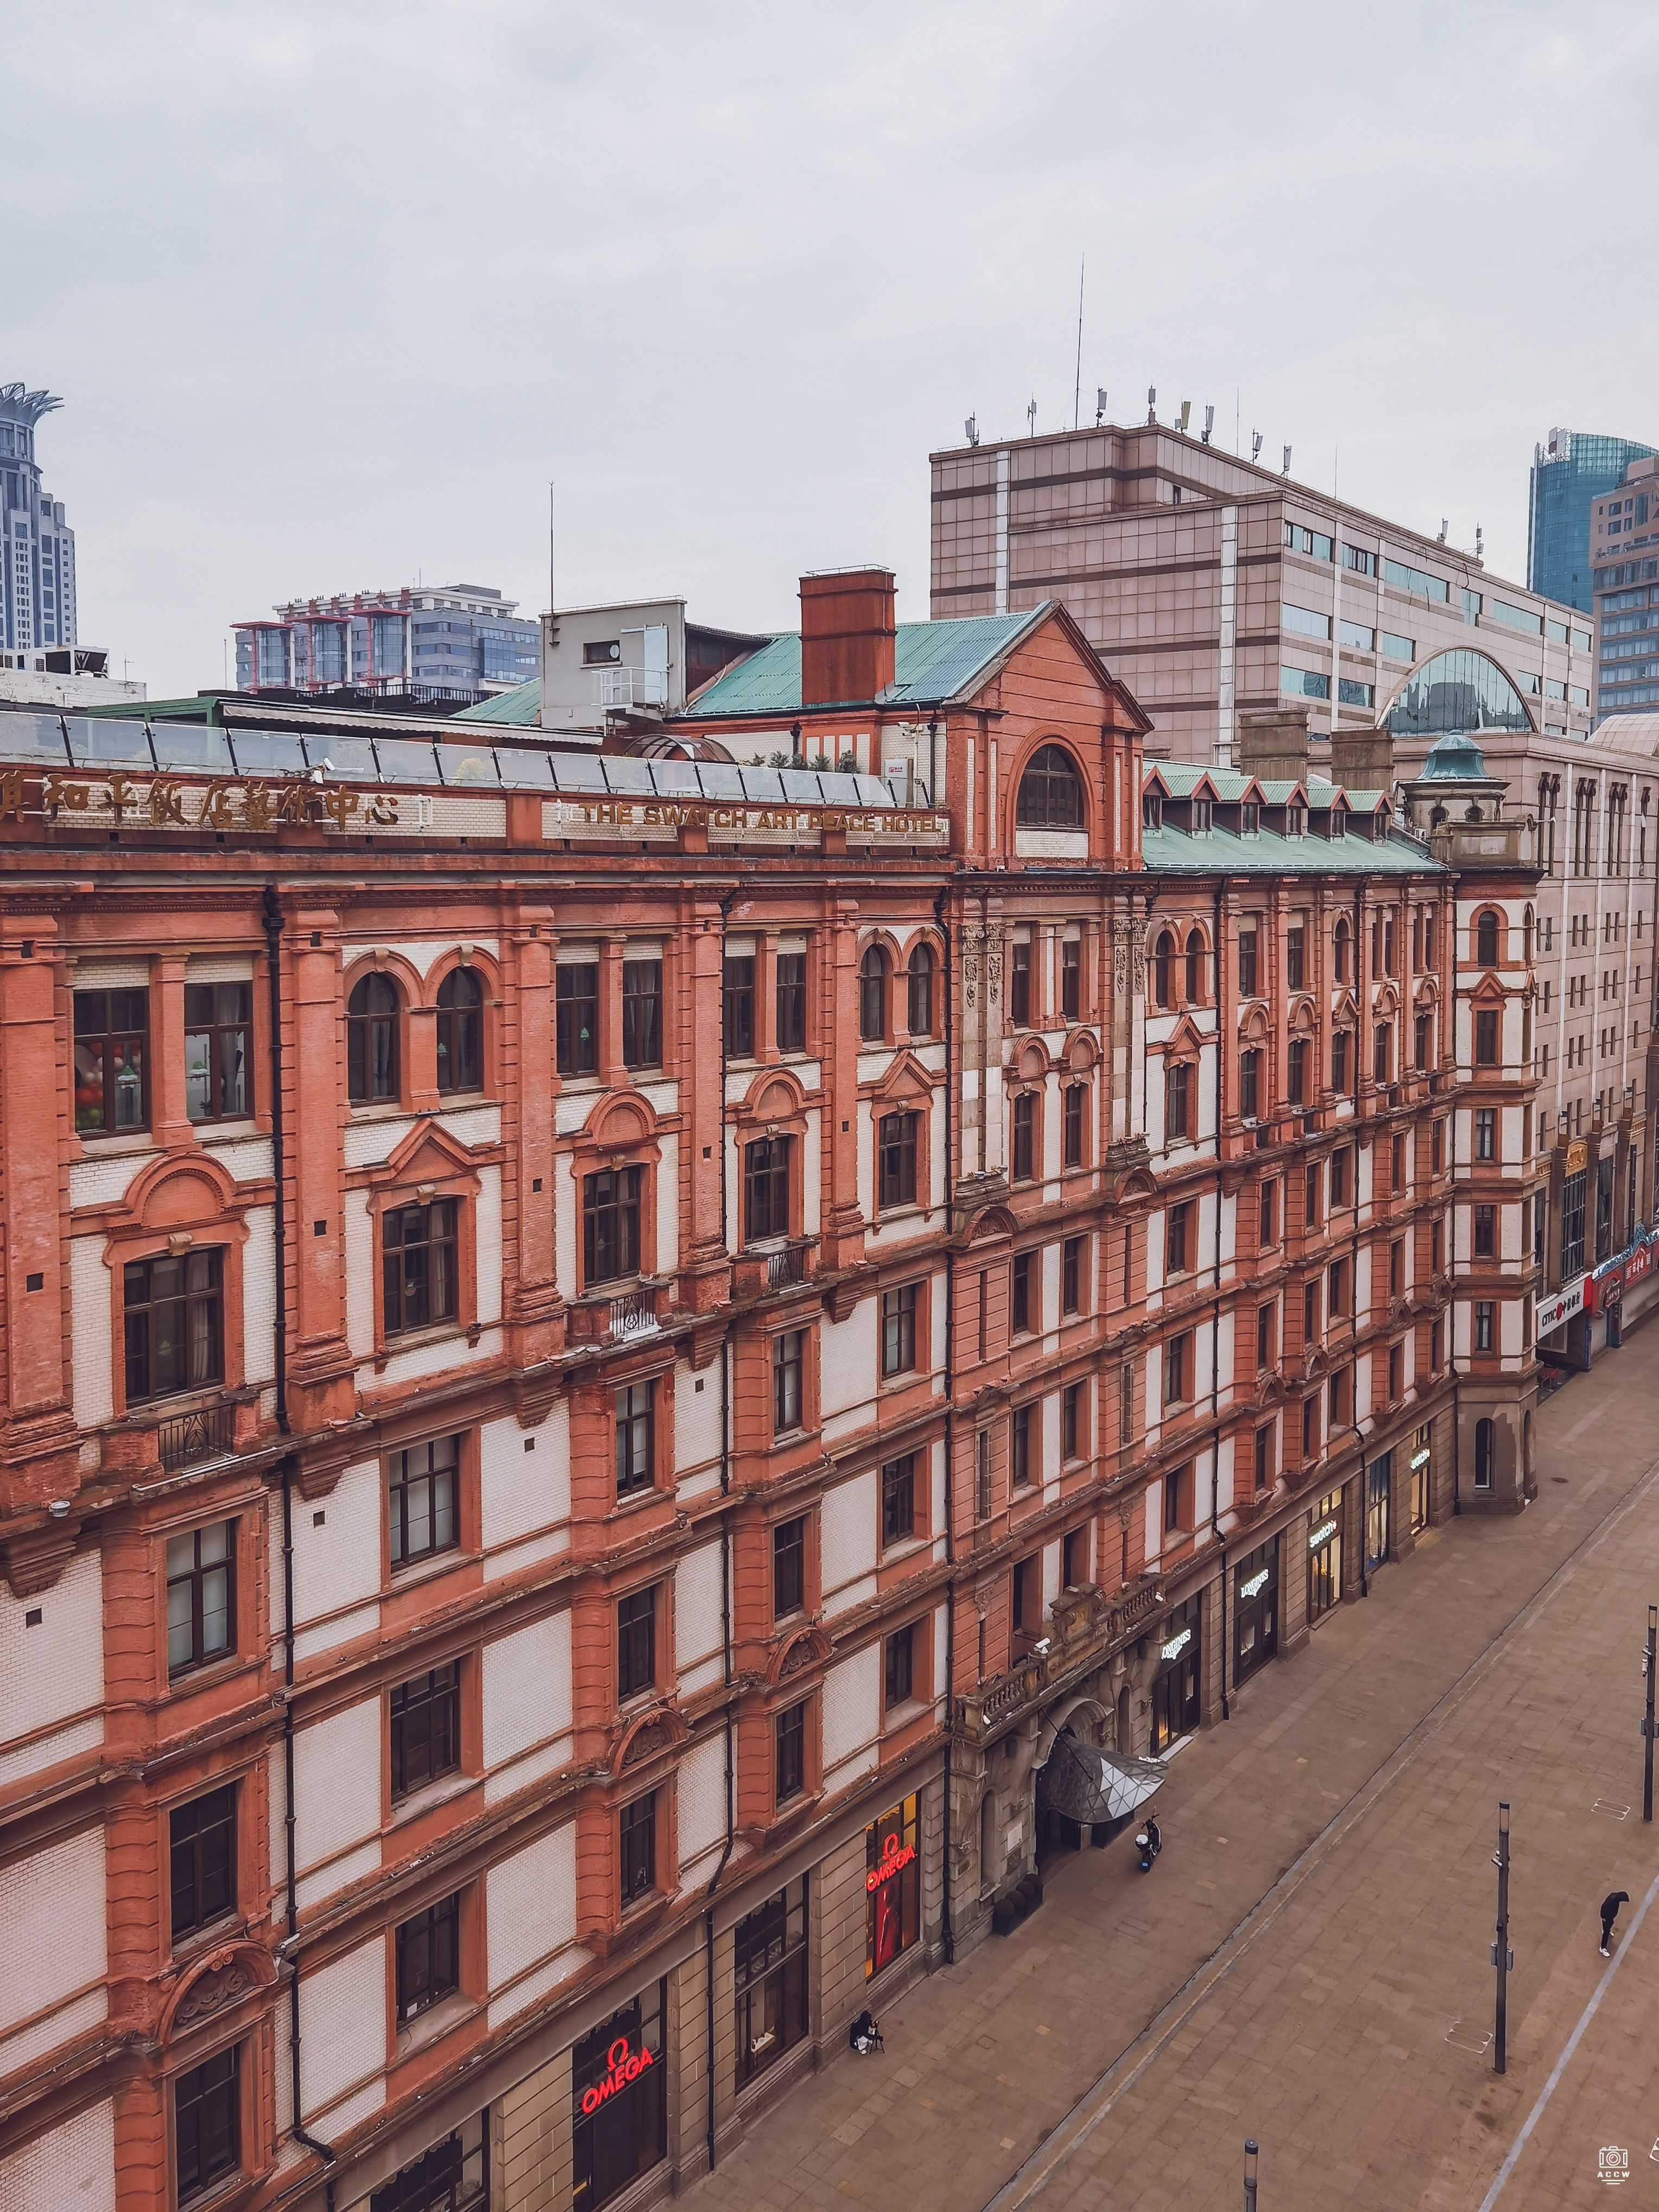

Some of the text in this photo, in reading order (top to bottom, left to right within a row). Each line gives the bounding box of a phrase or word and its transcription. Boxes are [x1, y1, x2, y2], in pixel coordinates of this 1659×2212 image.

[579, 803, 944, 833] THE SWATCH ART PLACE HOTEL
[1309, 1521, 1333, 1548] swatch
[1240, 1569, 1269, 1598] LONGINES
[1161, 1629, 1191, 1659] ONGINES
[867, 1843, 915, 1892] OMEGA
[582, 2046, 654, 2114] OMEGA
